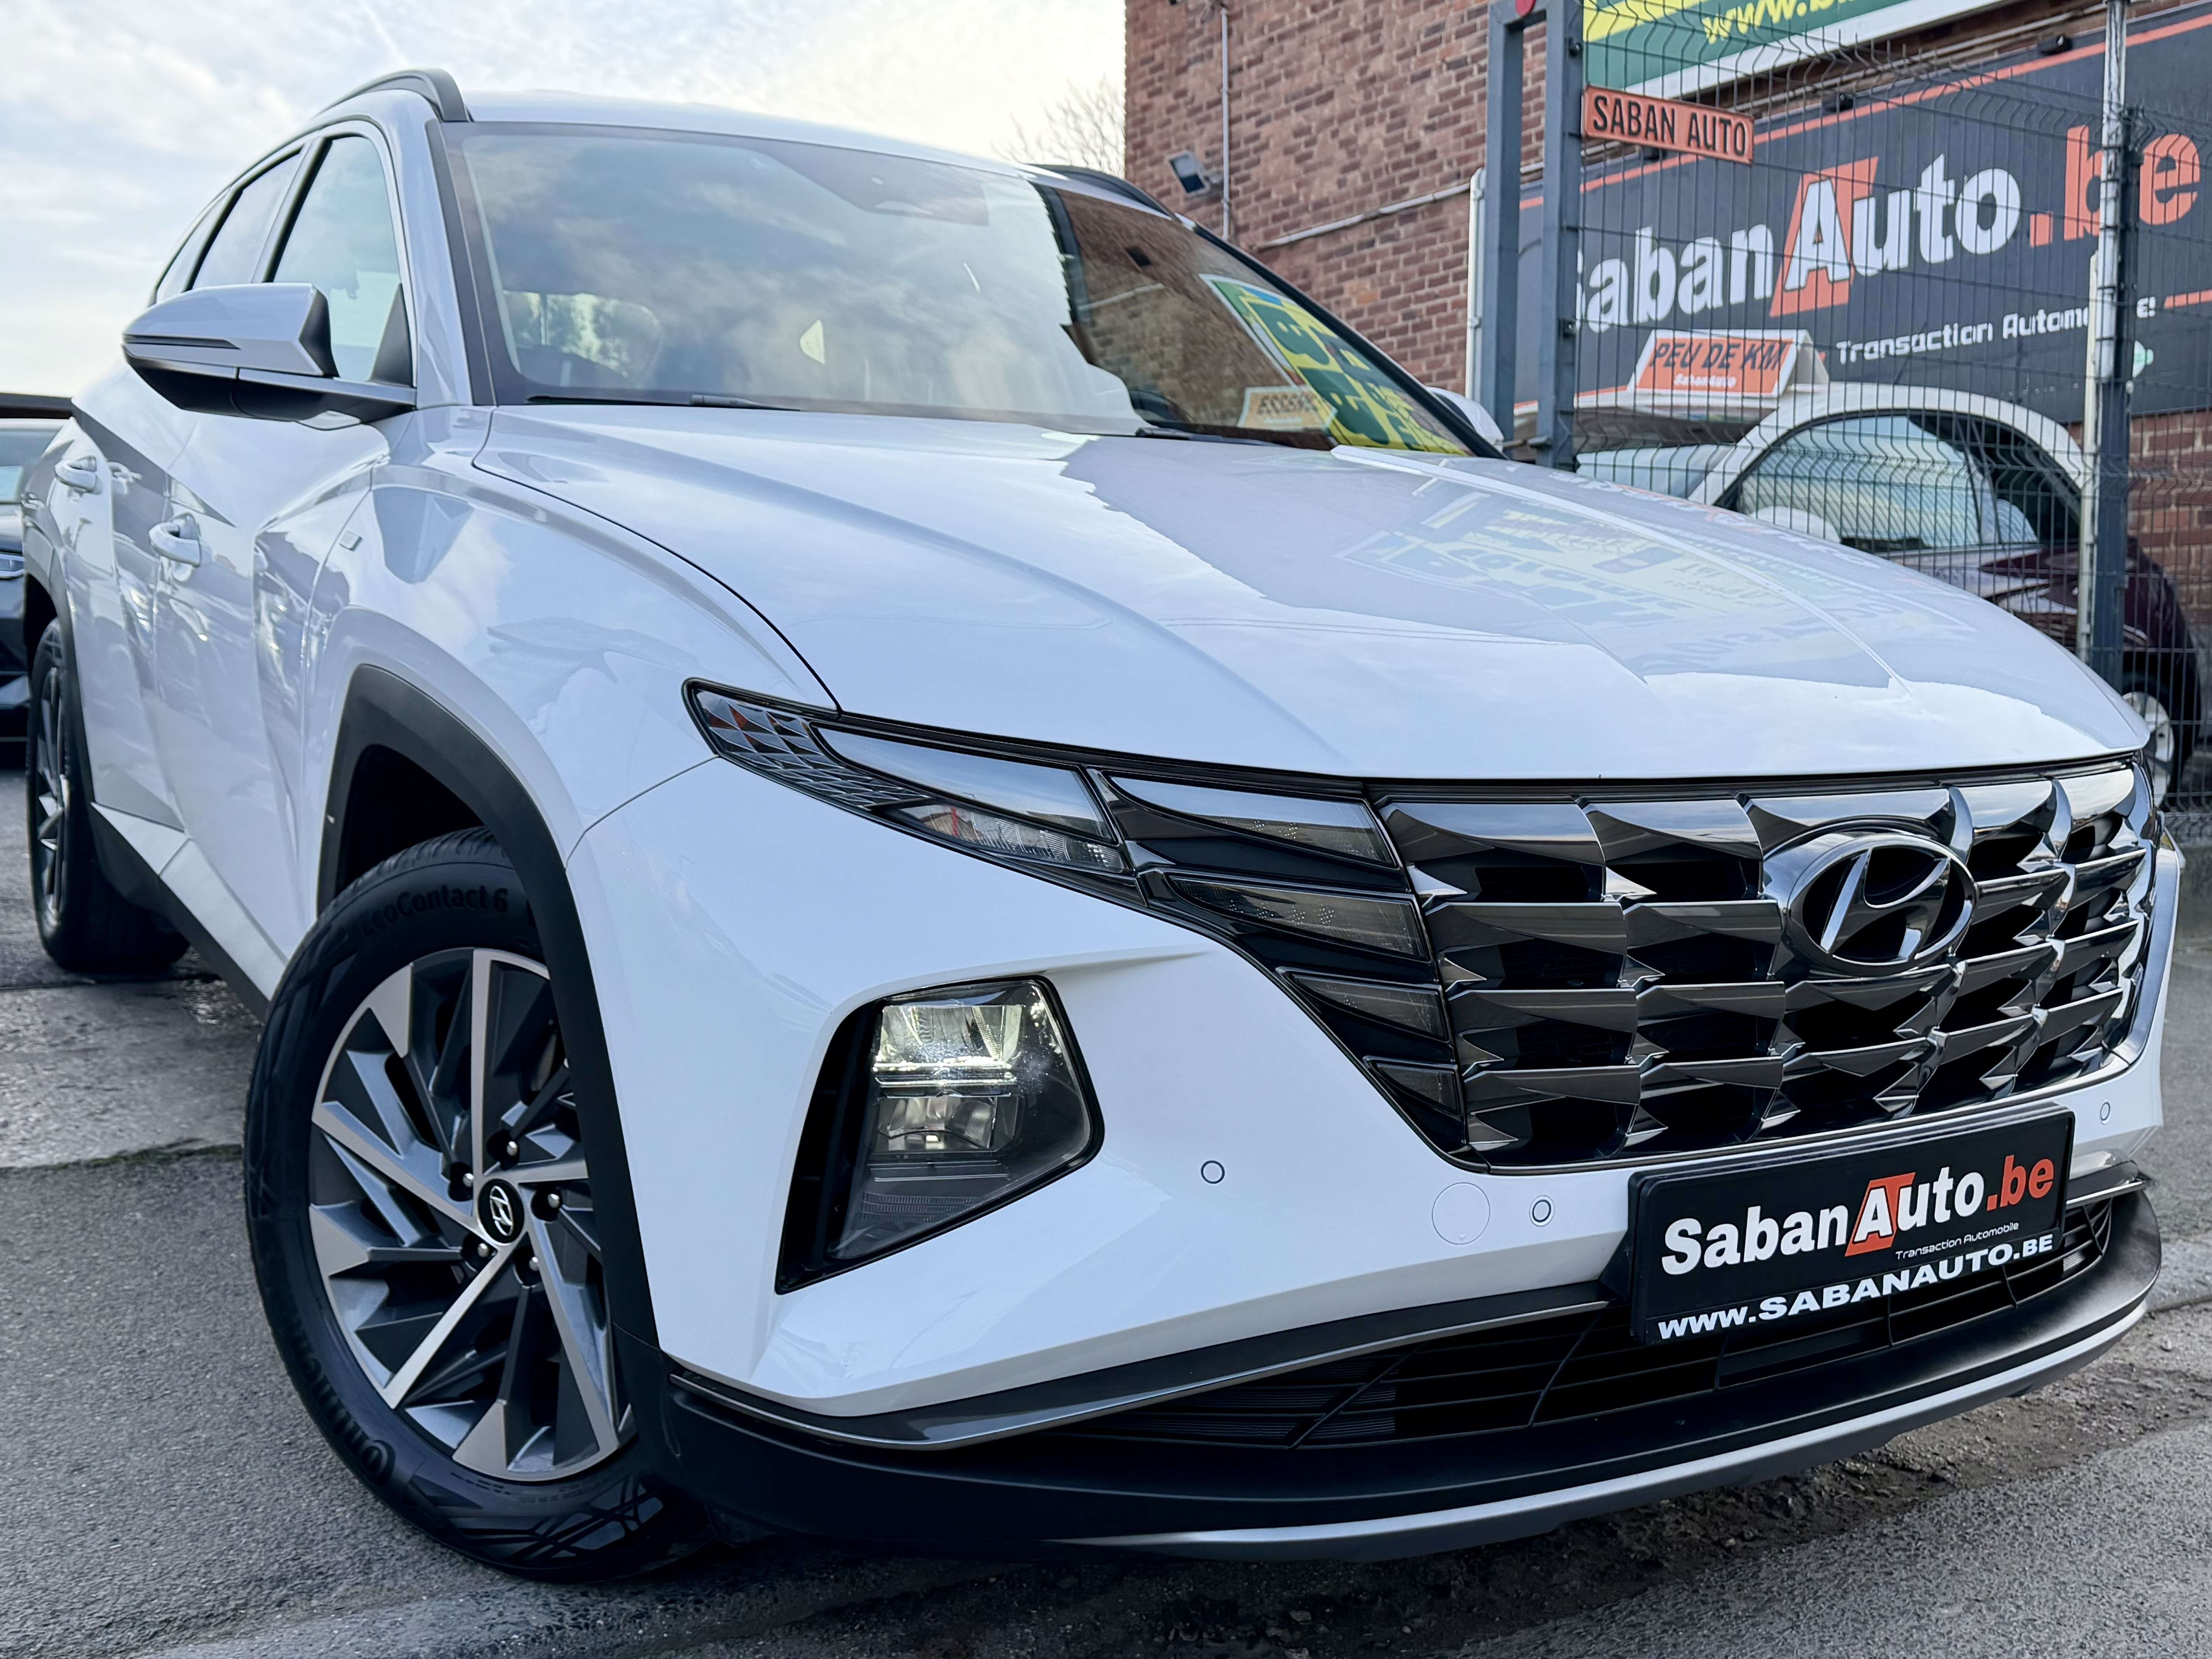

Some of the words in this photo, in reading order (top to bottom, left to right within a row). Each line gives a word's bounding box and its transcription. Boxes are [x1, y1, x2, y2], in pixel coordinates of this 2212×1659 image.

[1593, 94, 1676, 145] SABAN
[1686, 115, 1746, 157] AUTO
[1649, 343, 1702, 369] PEU
[1704, 343, 1740, 369] DE
[1739, 342, 1786, 371] KM
[1836, 322, 1994, 365] Transaction
[2002, 296, 2156, 339] Autome
[362, 884, 486, 937] EcoContact
[493, 887, 509, 913] 6
[1662, 1155, 2054, 1275] SabanAuto.be
[1895, 1238, 1961, 1260] Transaction
[1963, 1222, 2020, 1244] Automobile
